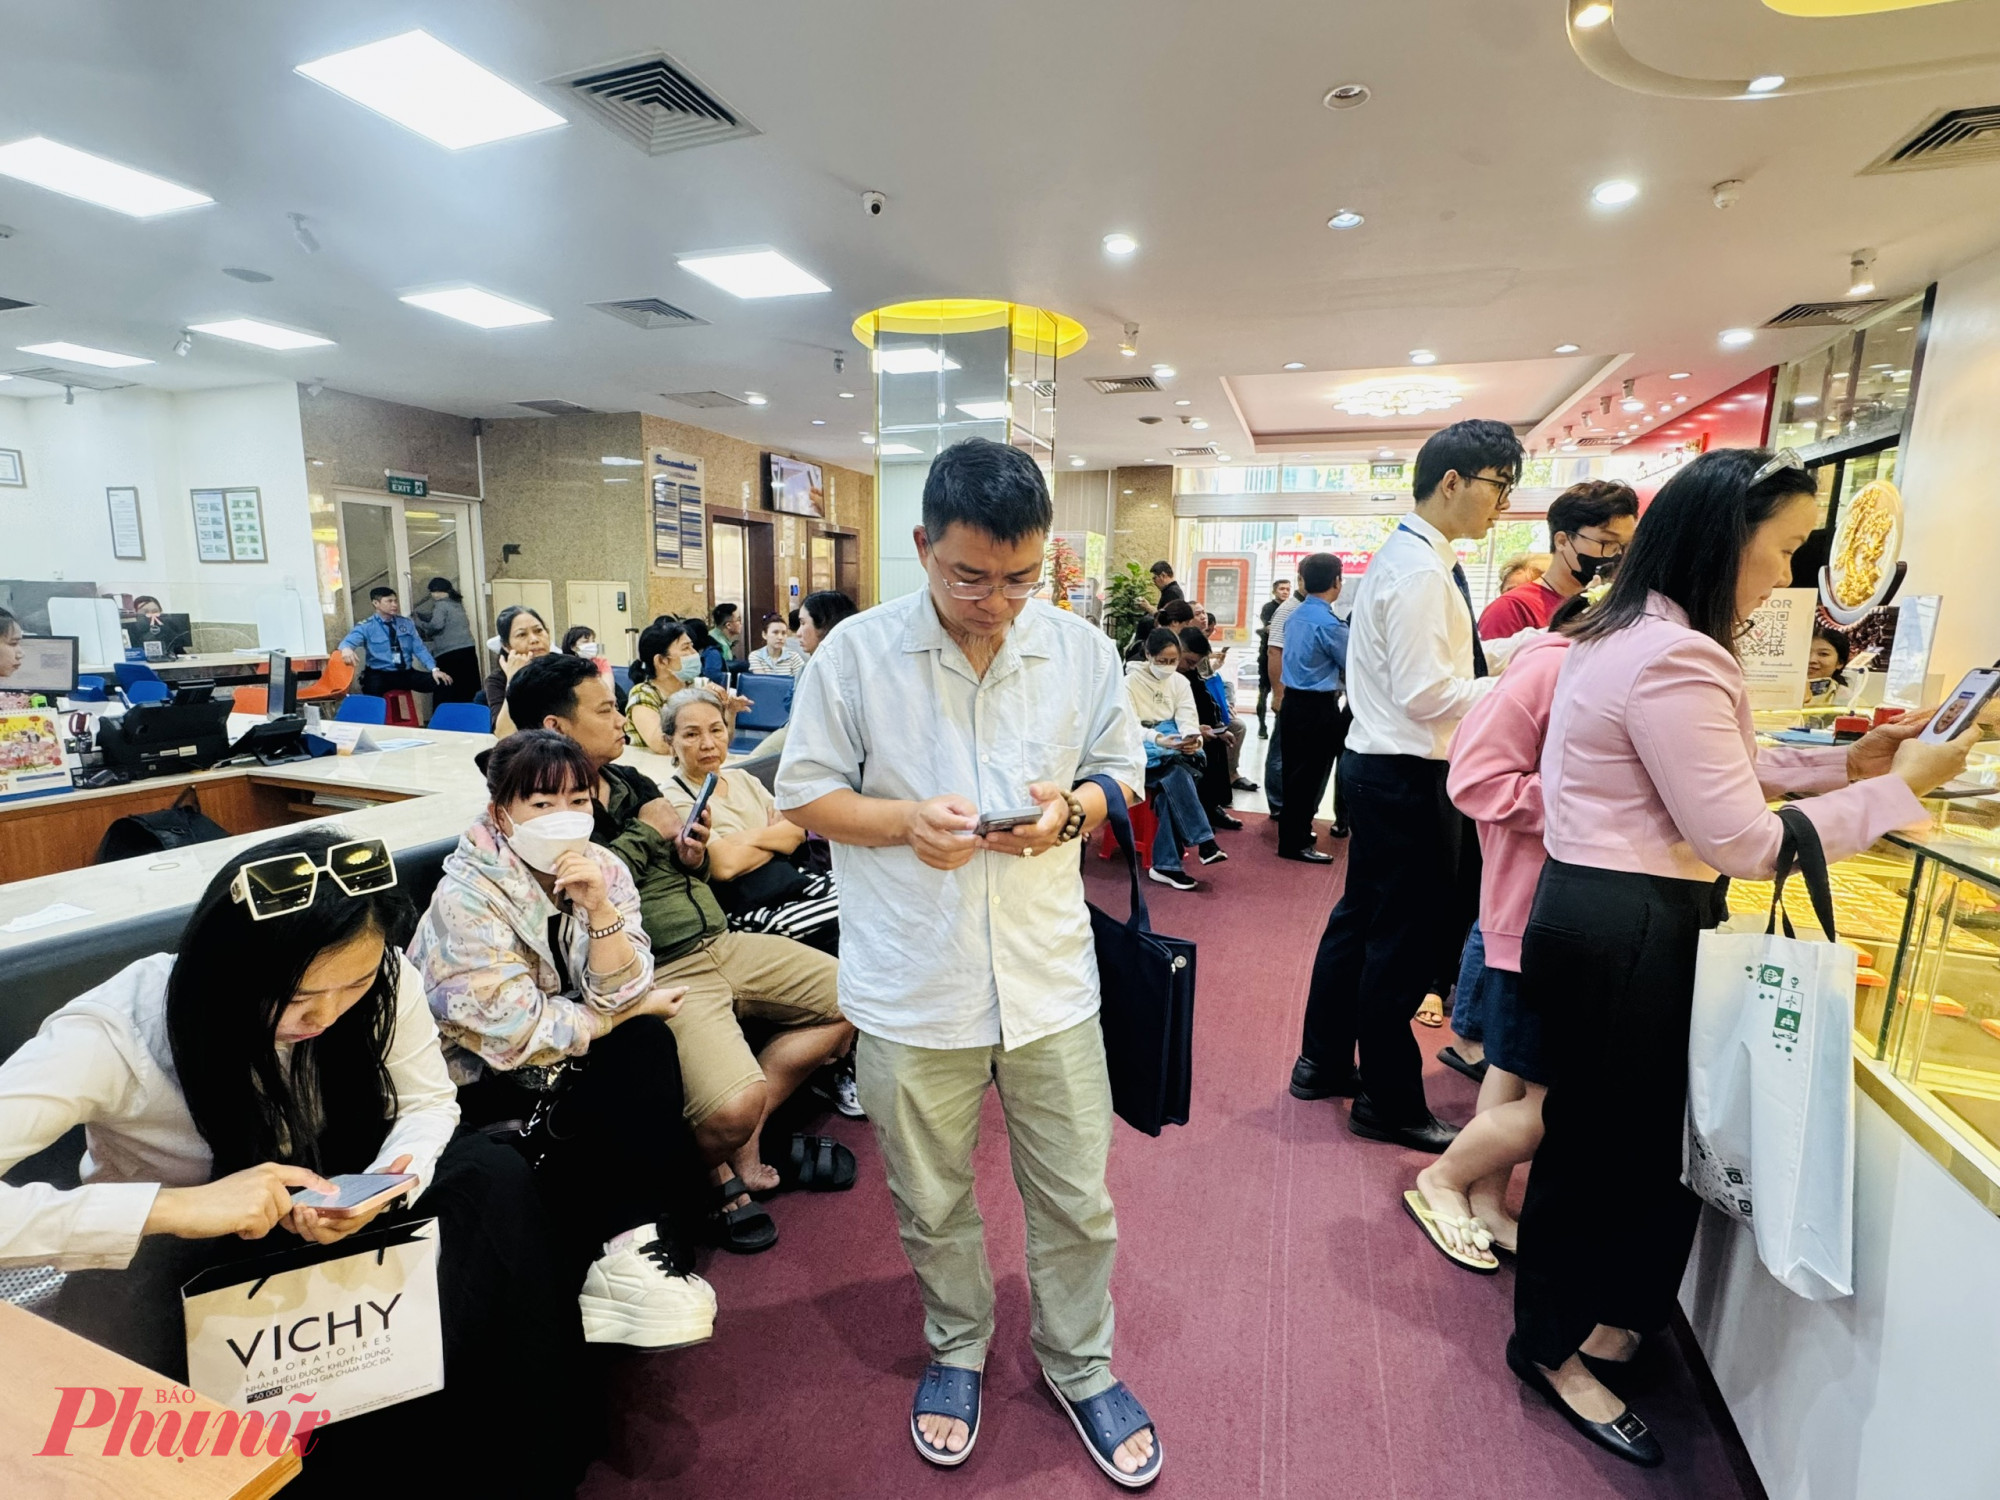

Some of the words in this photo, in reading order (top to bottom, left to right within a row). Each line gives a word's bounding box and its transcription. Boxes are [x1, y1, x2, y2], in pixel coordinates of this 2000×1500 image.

[392, 484, 411, 493] EXIT
[226, 1292, 403, 1369] VICHY
[245, 1334, 392, 1382] LABORATOIRES
[319, 1373, 334, 1382] GIA
